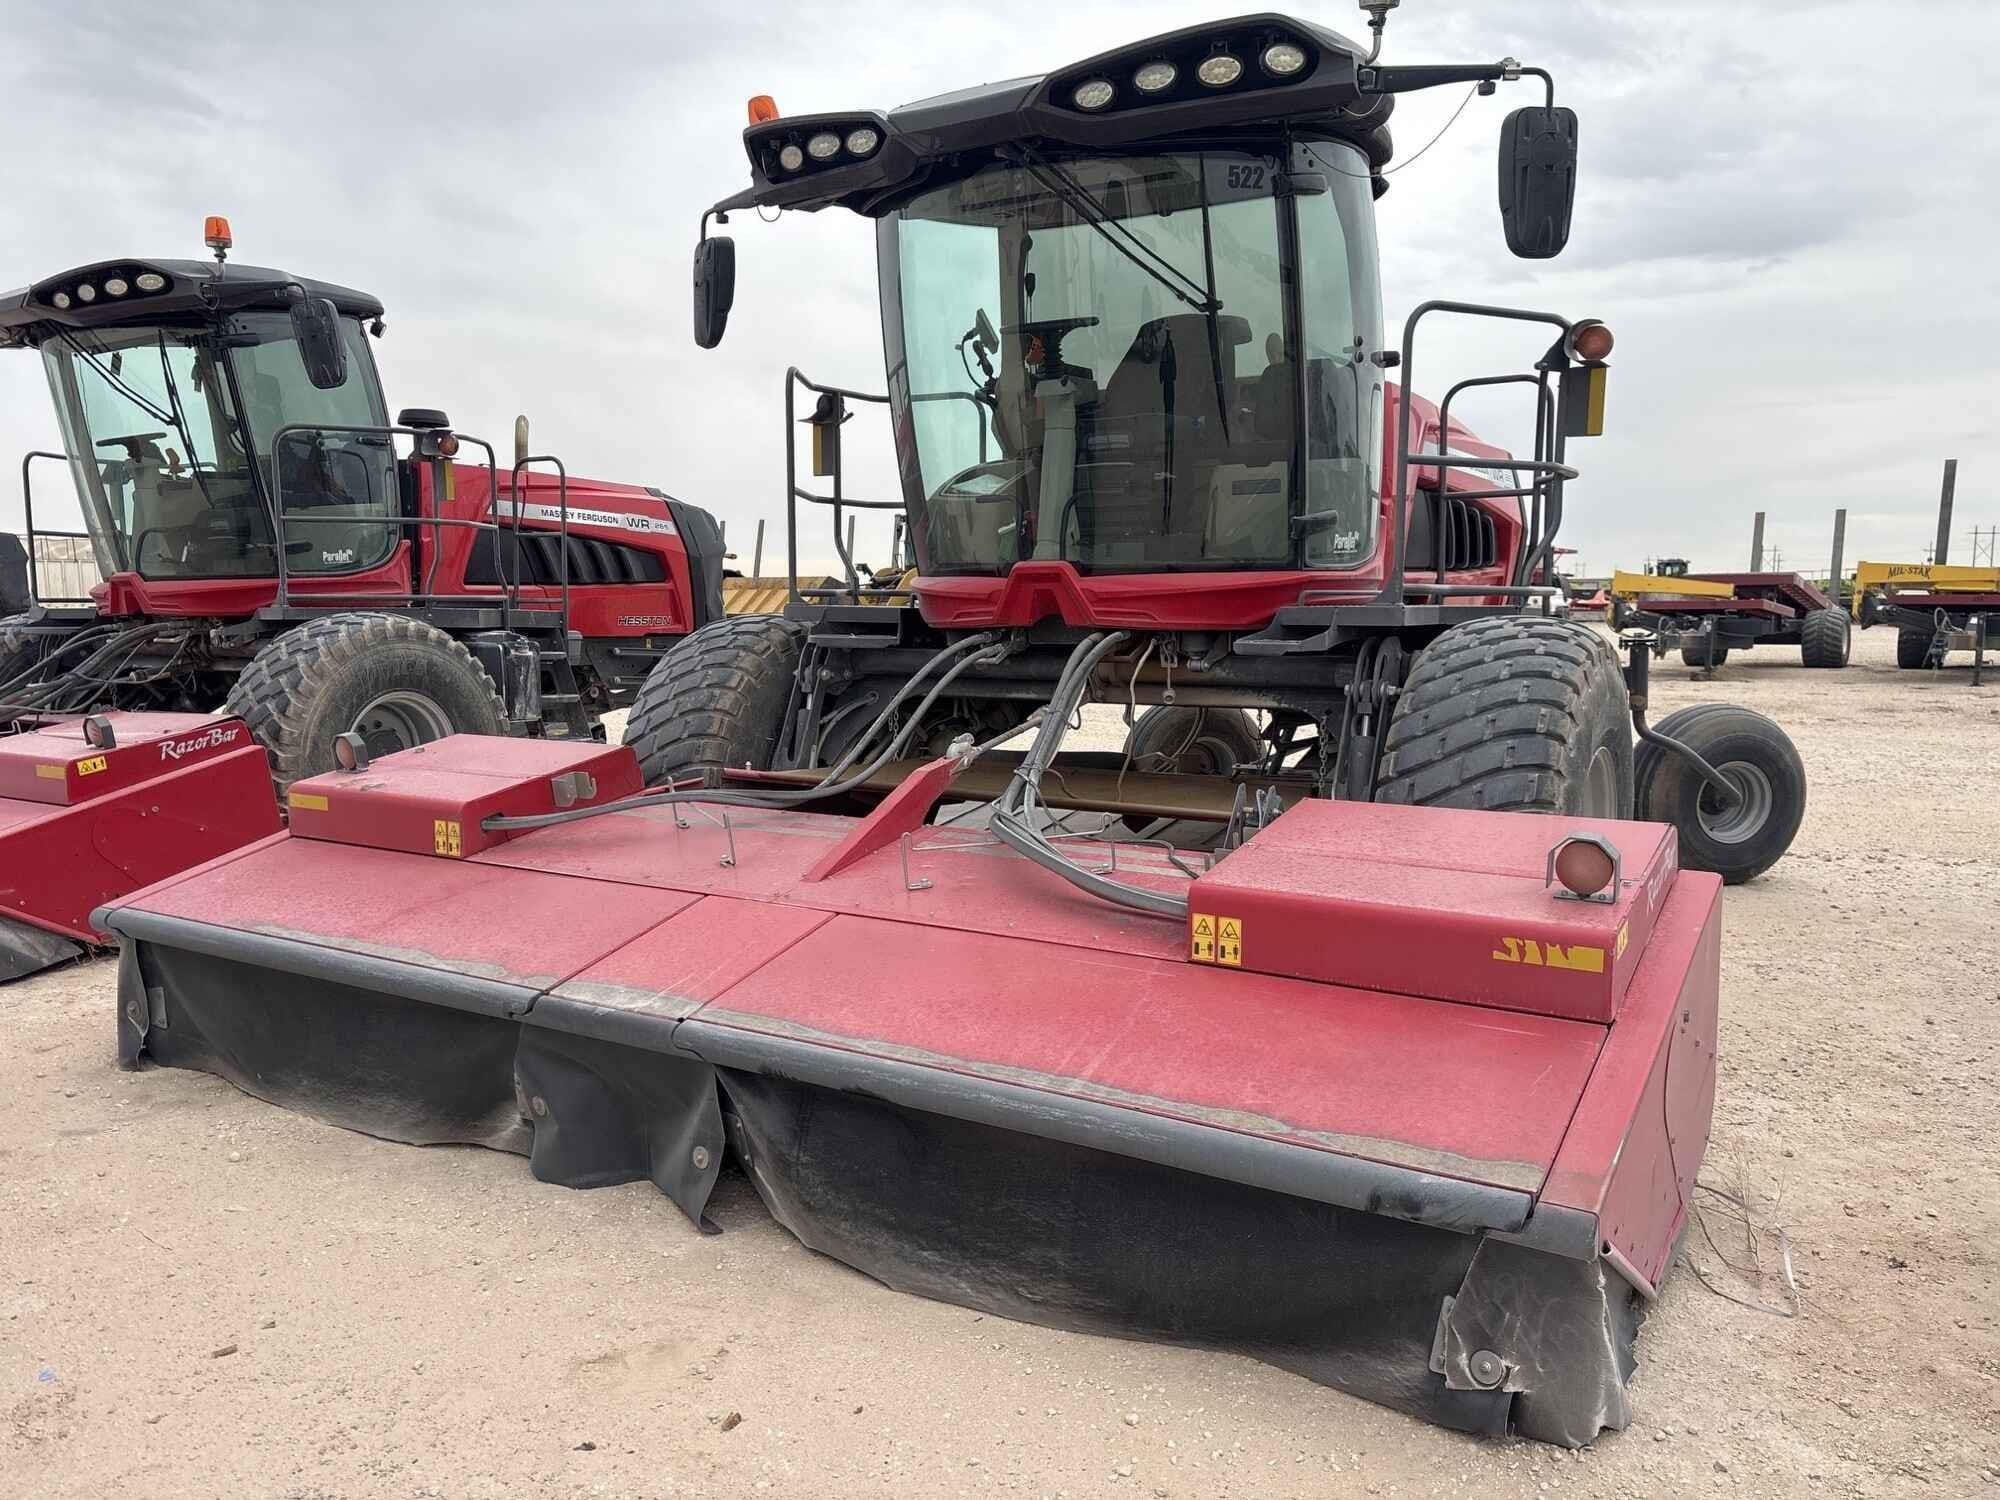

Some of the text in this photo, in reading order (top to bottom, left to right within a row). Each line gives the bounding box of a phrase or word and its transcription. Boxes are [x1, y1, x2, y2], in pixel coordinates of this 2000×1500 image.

[1227, 164, 1265, 190] 522
[541, 508, 574, 520] MASEY
[577, 511, 619, 525] FERGUSON
[626, 516, 650, 530] WR
[617, 615, 672, 627] HESSTON
[157, 728, 239, 760] RazorBar
